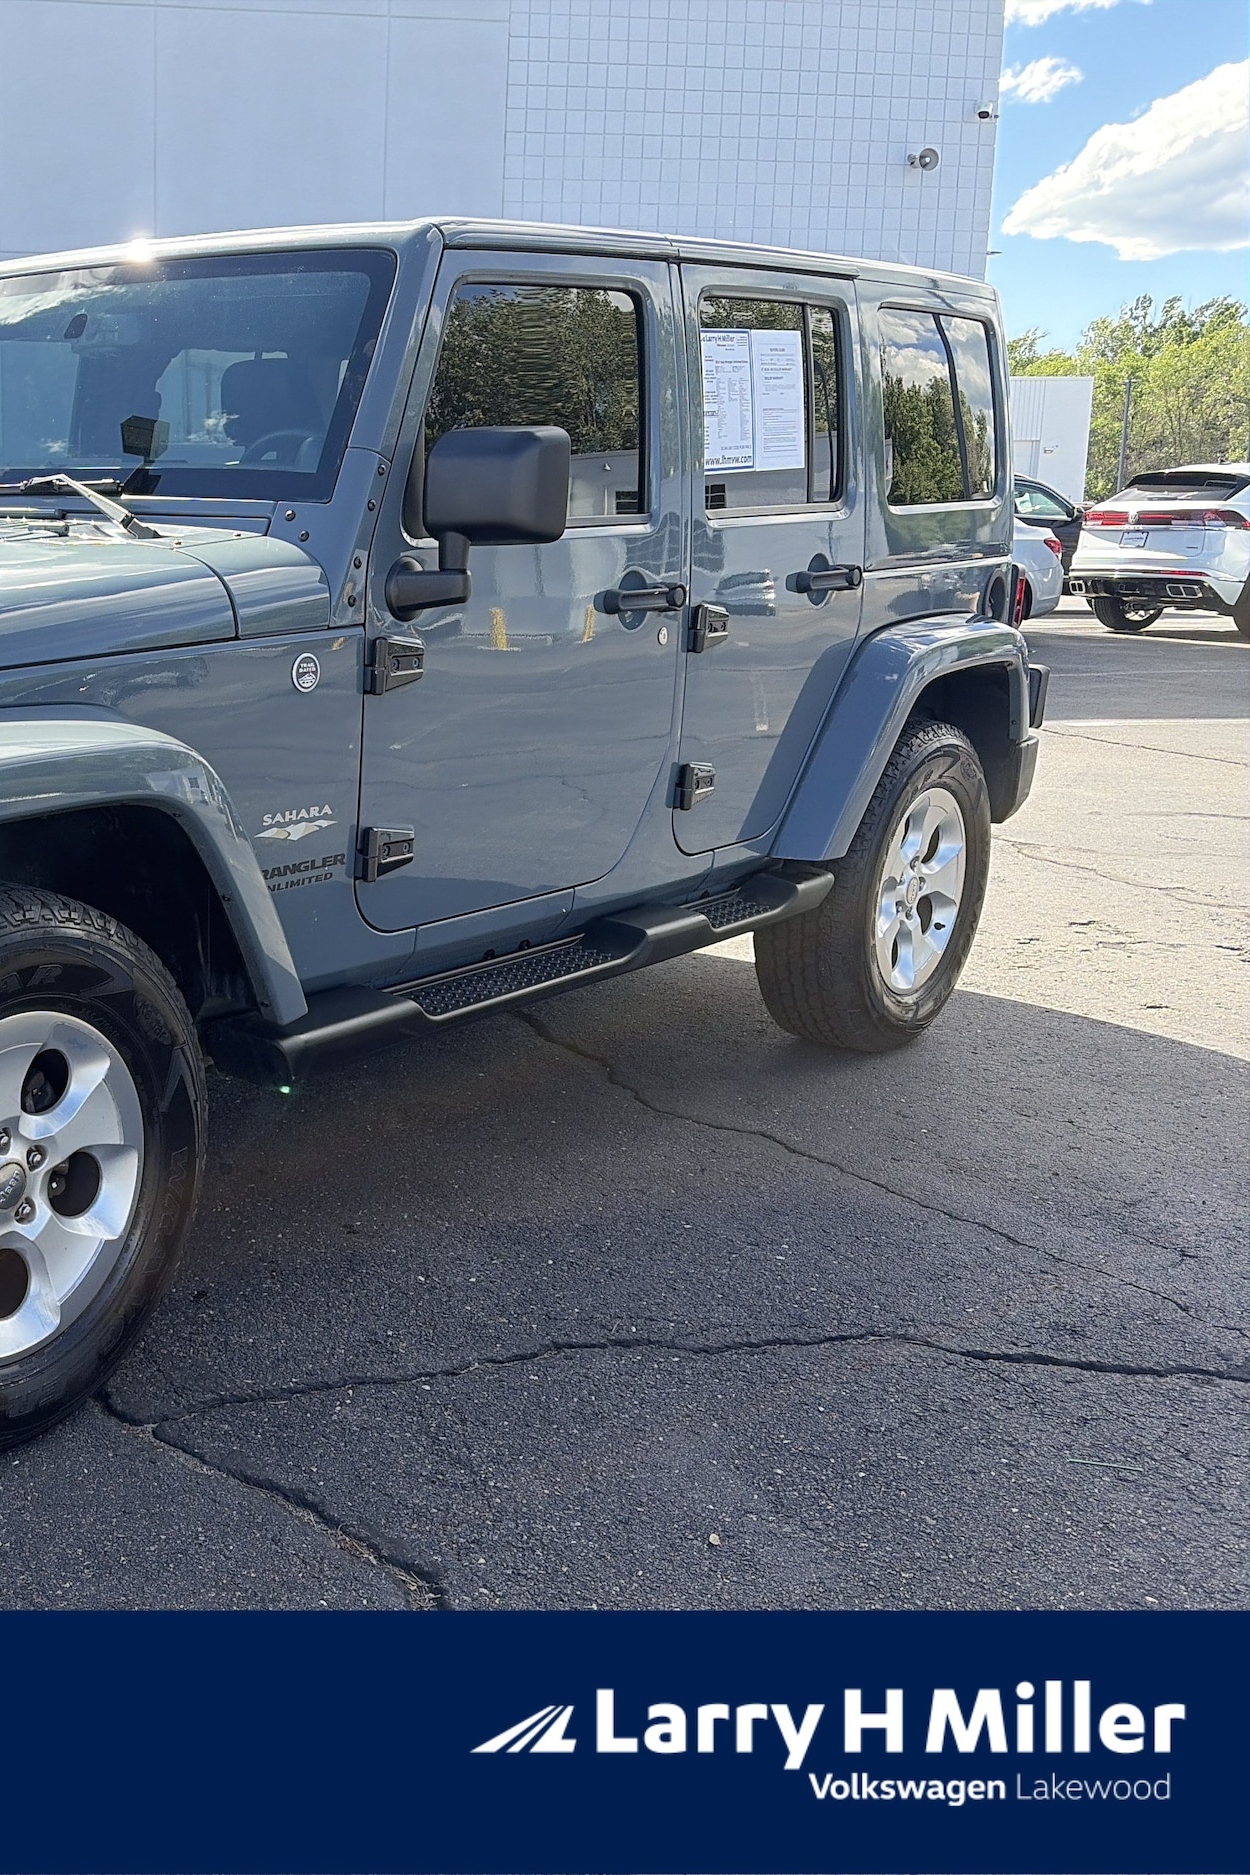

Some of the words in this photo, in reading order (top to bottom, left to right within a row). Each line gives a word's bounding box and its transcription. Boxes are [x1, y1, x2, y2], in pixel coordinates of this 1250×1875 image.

[262, 804, 333, 826] SAHARA
[261, 853, 346, 880] RANGLER
[267, 872, 333, 892] NLIMITED
